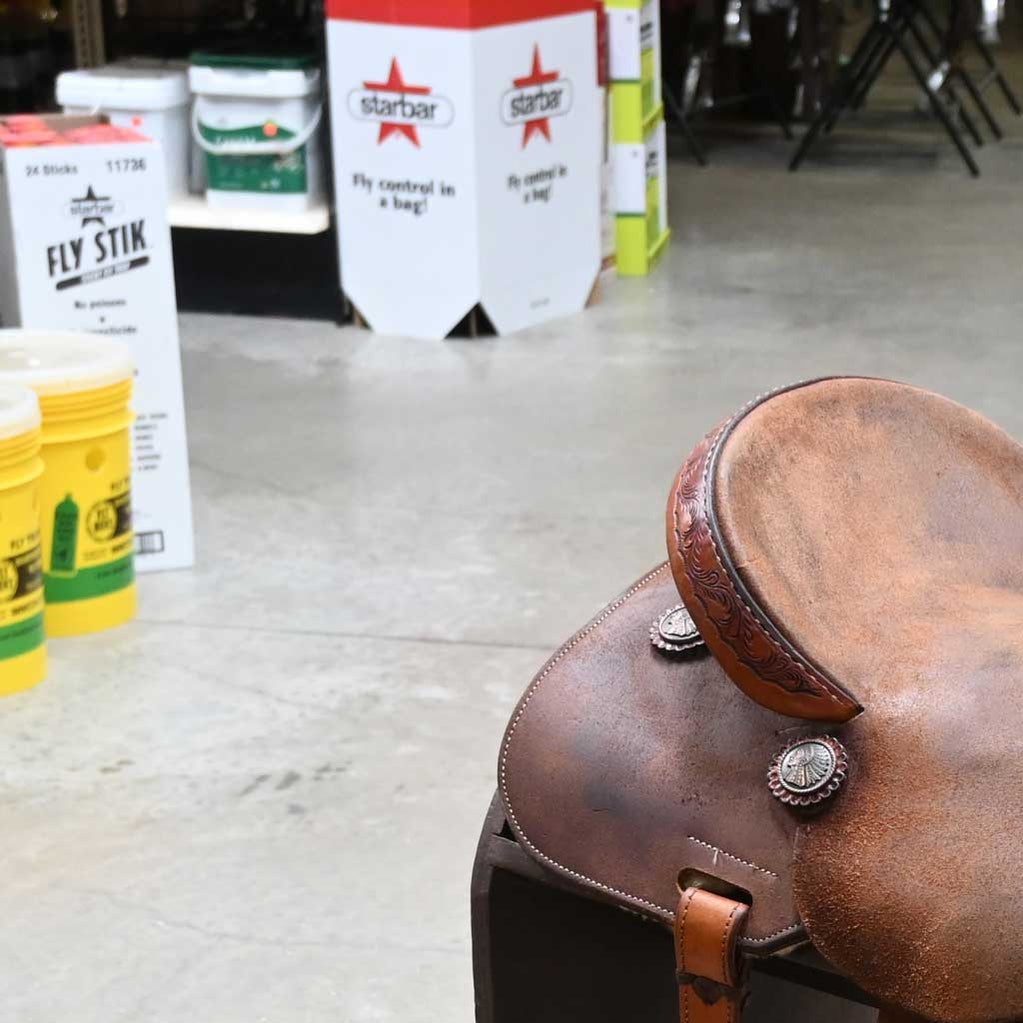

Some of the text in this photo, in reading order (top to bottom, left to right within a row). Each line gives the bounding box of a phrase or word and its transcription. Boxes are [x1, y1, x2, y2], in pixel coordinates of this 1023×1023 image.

[361, 91, 438, 119] starbar
[511, 85, 563, 118] starbar
[43, 163, 78, 175] Sticks
[353, 173, 456, 196] Fly control in
[379, 194, 428, 216] a bag!
[47, 237, 83, 278] FLY
[94, 218, 147, 263] STIK
